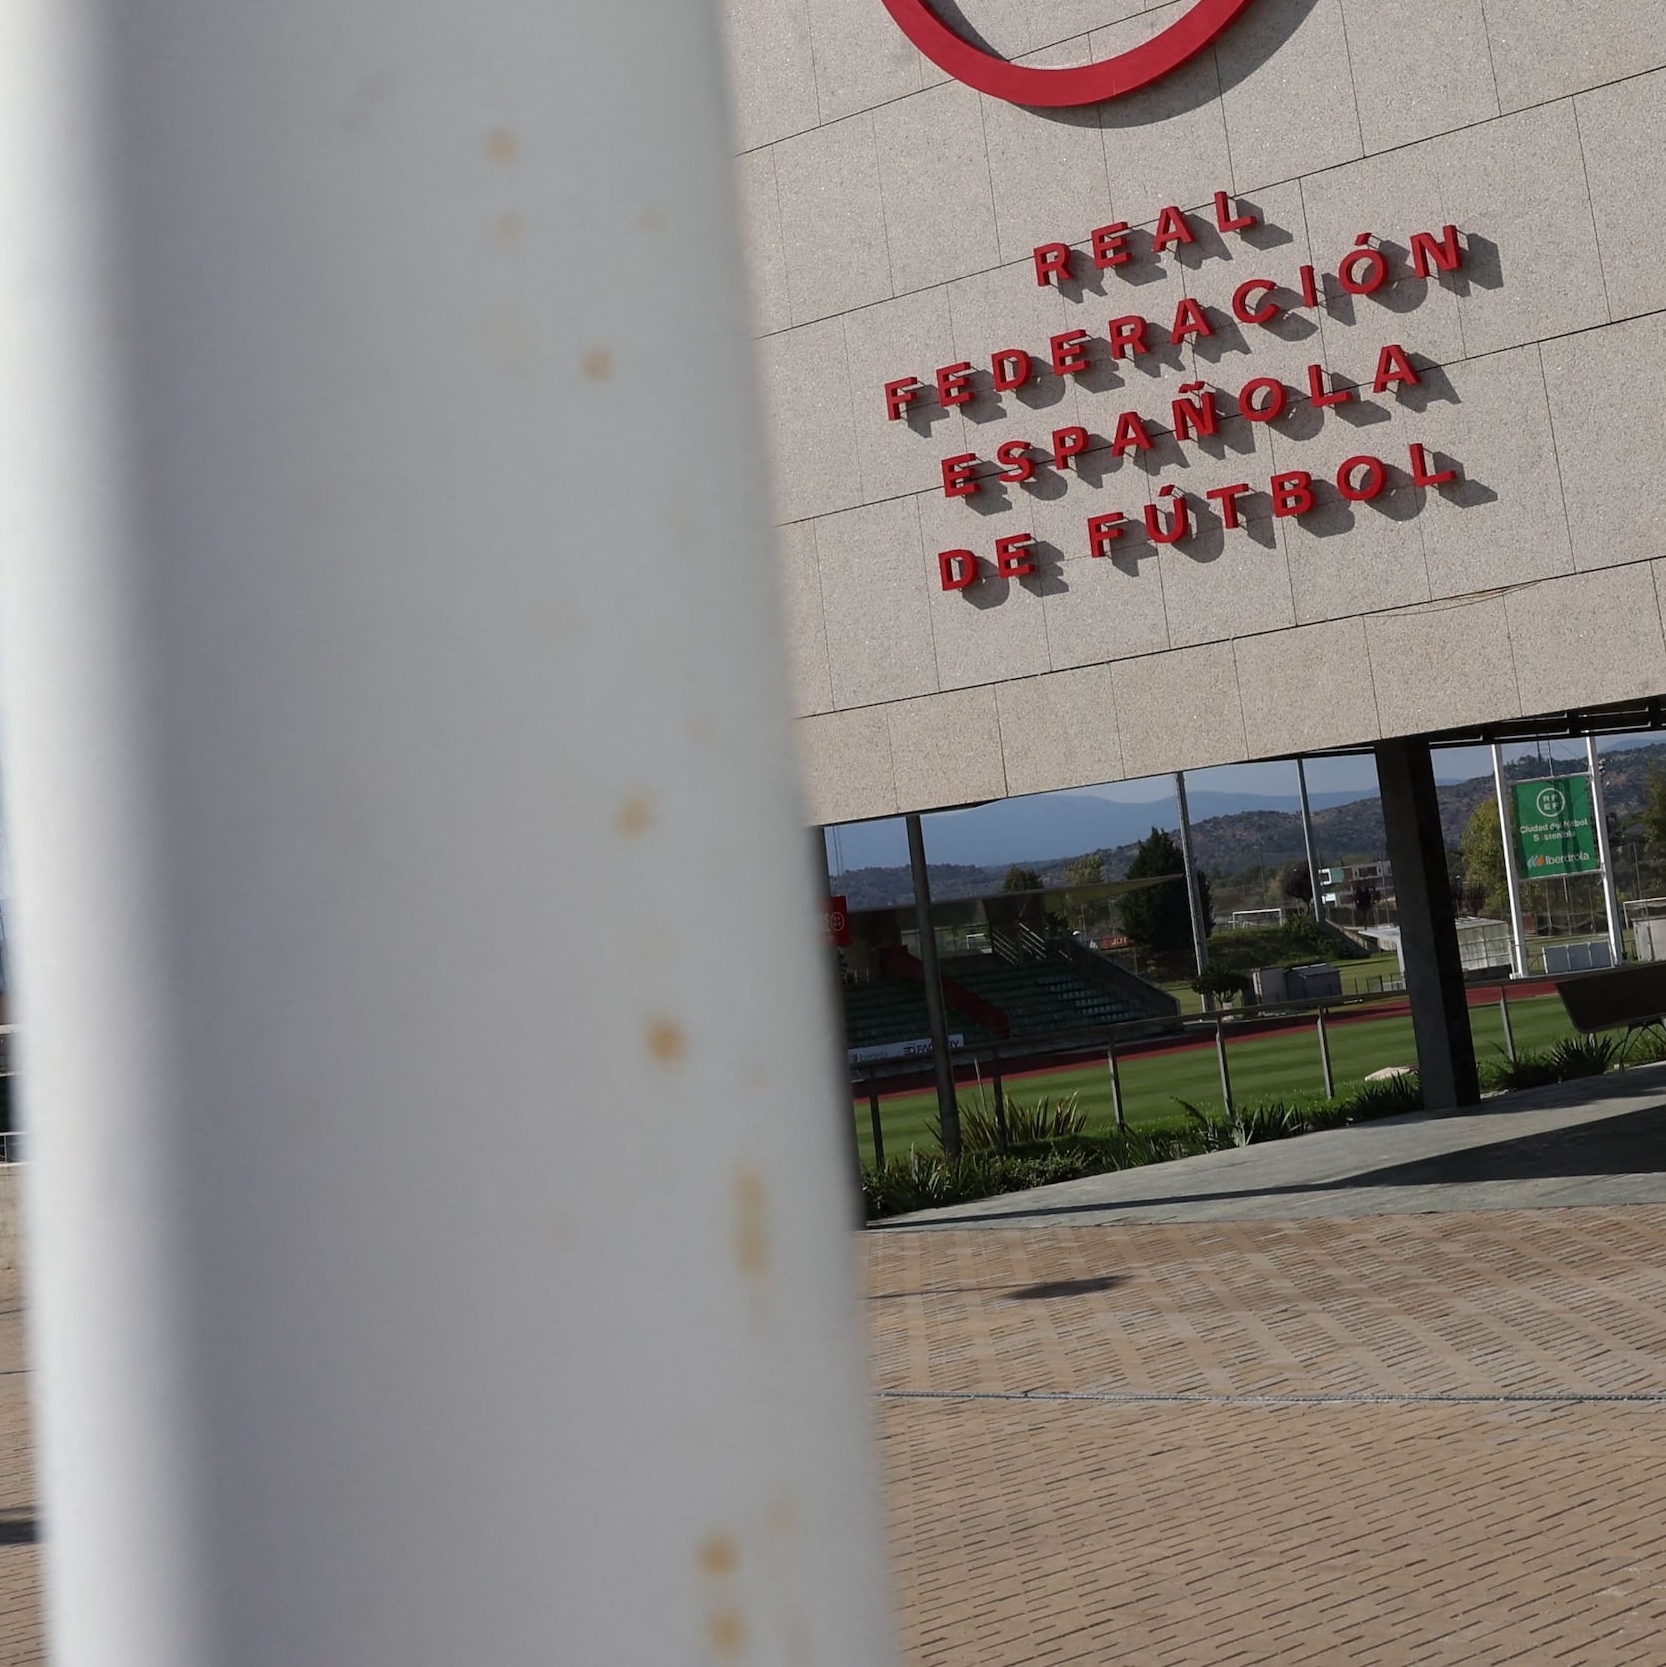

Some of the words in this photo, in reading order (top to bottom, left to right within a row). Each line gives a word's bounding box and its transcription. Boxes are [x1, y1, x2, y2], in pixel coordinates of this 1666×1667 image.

[1033, 190, 1257, 287] REAL
[884, 224, 1462, 421] FEDERACIÓN
[941, 344, 1421, 498] ESPAÑOLA
[939, 533, 1035, 591] DE
[1087, 442, 1457, 558] FÚTBOL
[1519, 823, 1548, 834] Ciudad
[1545, 851, 1590, 866] Iberdrola
